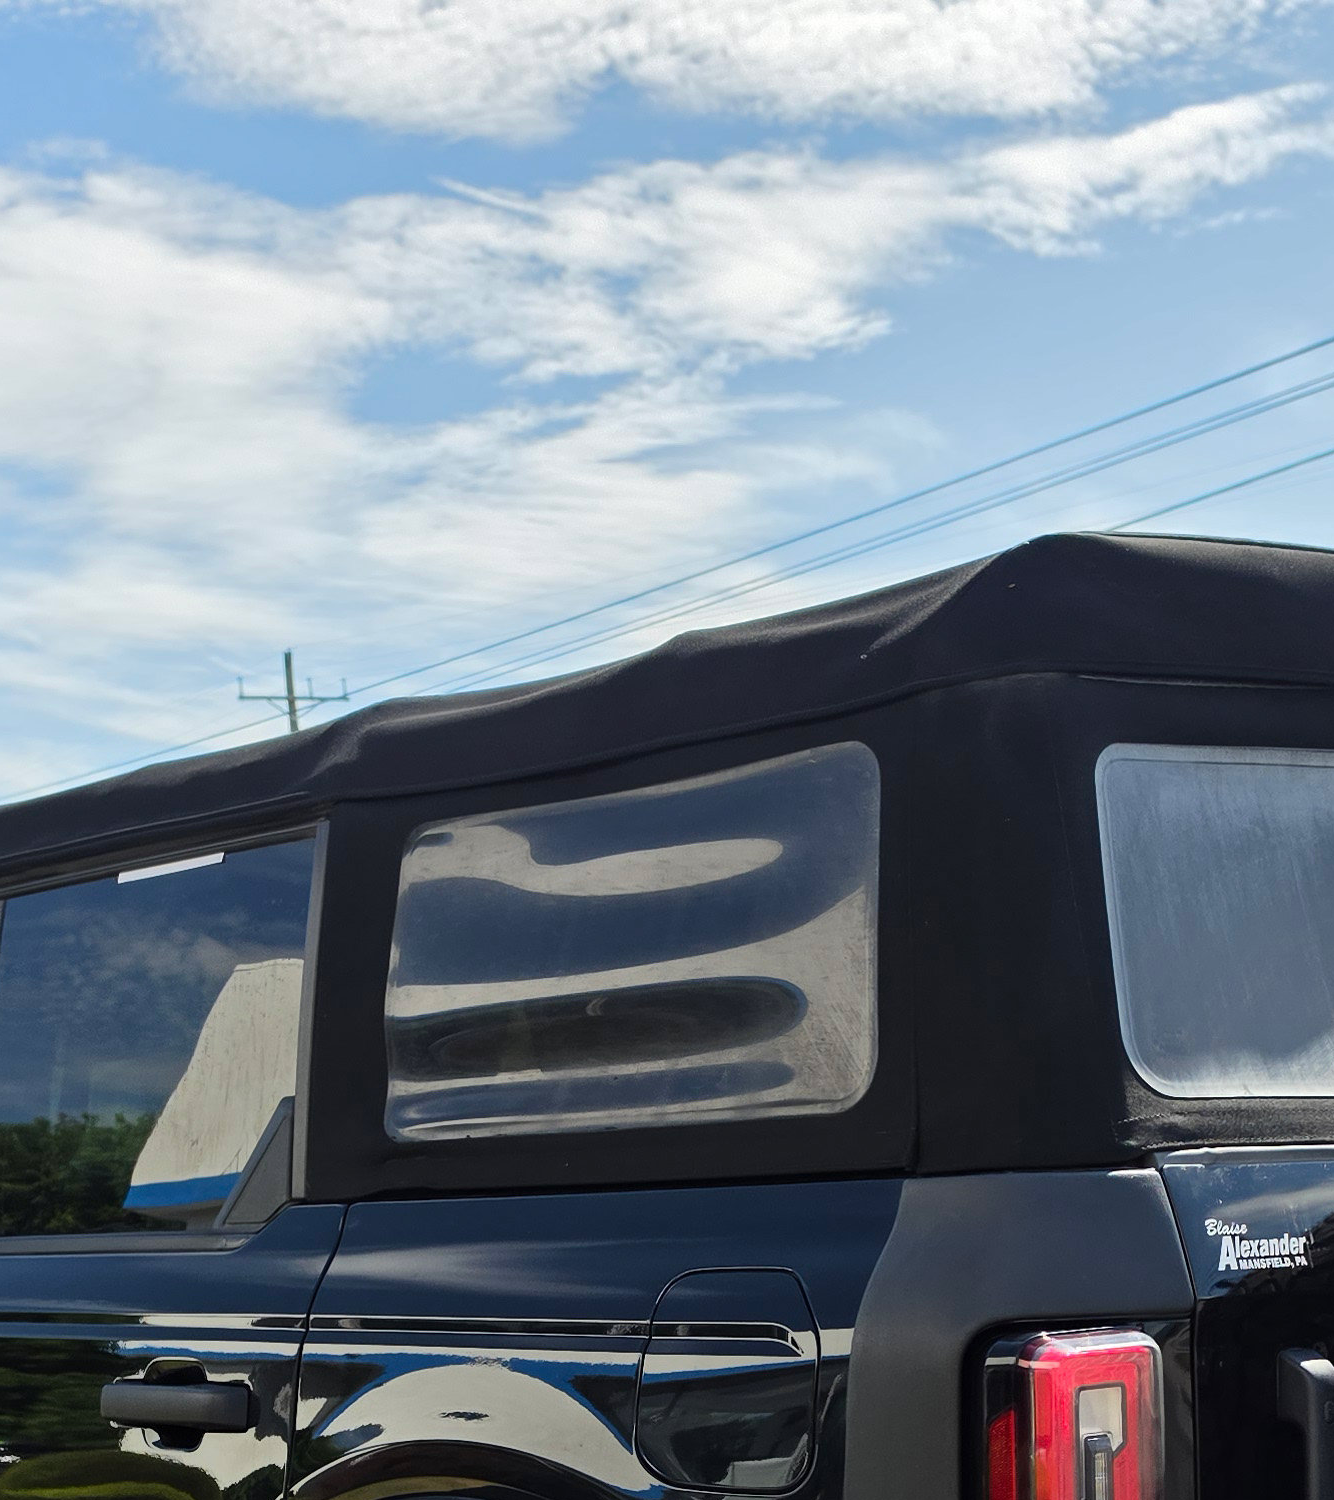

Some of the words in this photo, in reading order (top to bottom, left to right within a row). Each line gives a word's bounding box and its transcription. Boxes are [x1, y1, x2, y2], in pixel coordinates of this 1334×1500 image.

[1204, 1218, 1248, 1237] Blaise
[1218, 1233, 1306, 1271] Alexander
[1239, 1256, 1295, 1270] MANSFIELD,
[1295, 1255, 1308, 1267] PA
